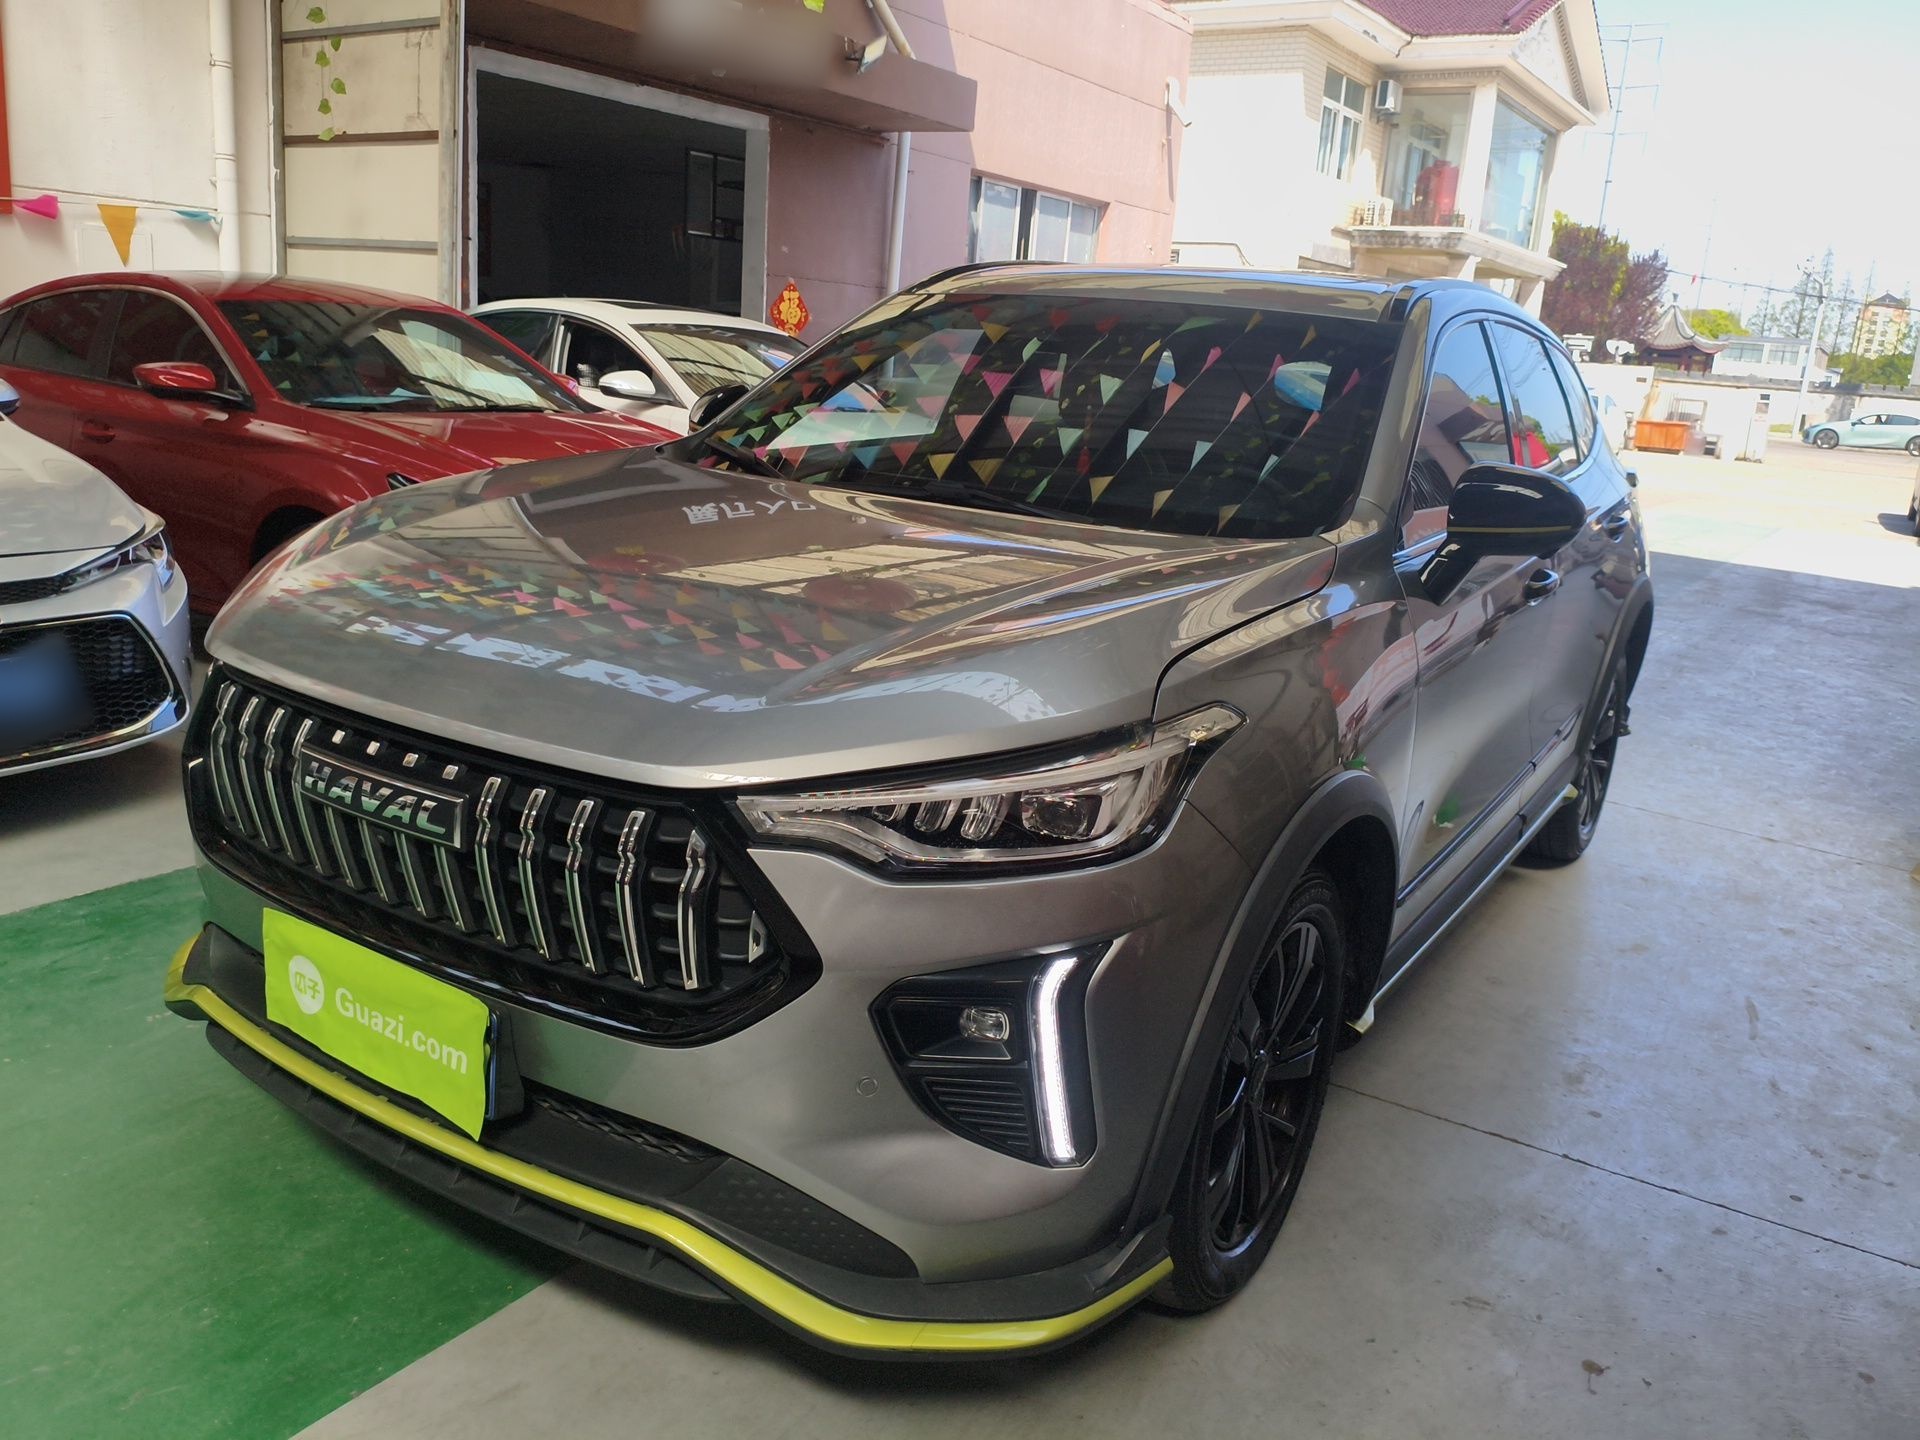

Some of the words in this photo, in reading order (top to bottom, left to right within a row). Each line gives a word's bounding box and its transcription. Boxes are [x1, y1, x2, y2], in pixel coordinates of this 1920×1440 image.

[779, 291, 801, 325] 福
[304, 761, 446, 835] HAVAL
[335, 987, 468, 1075] Guazi.com
